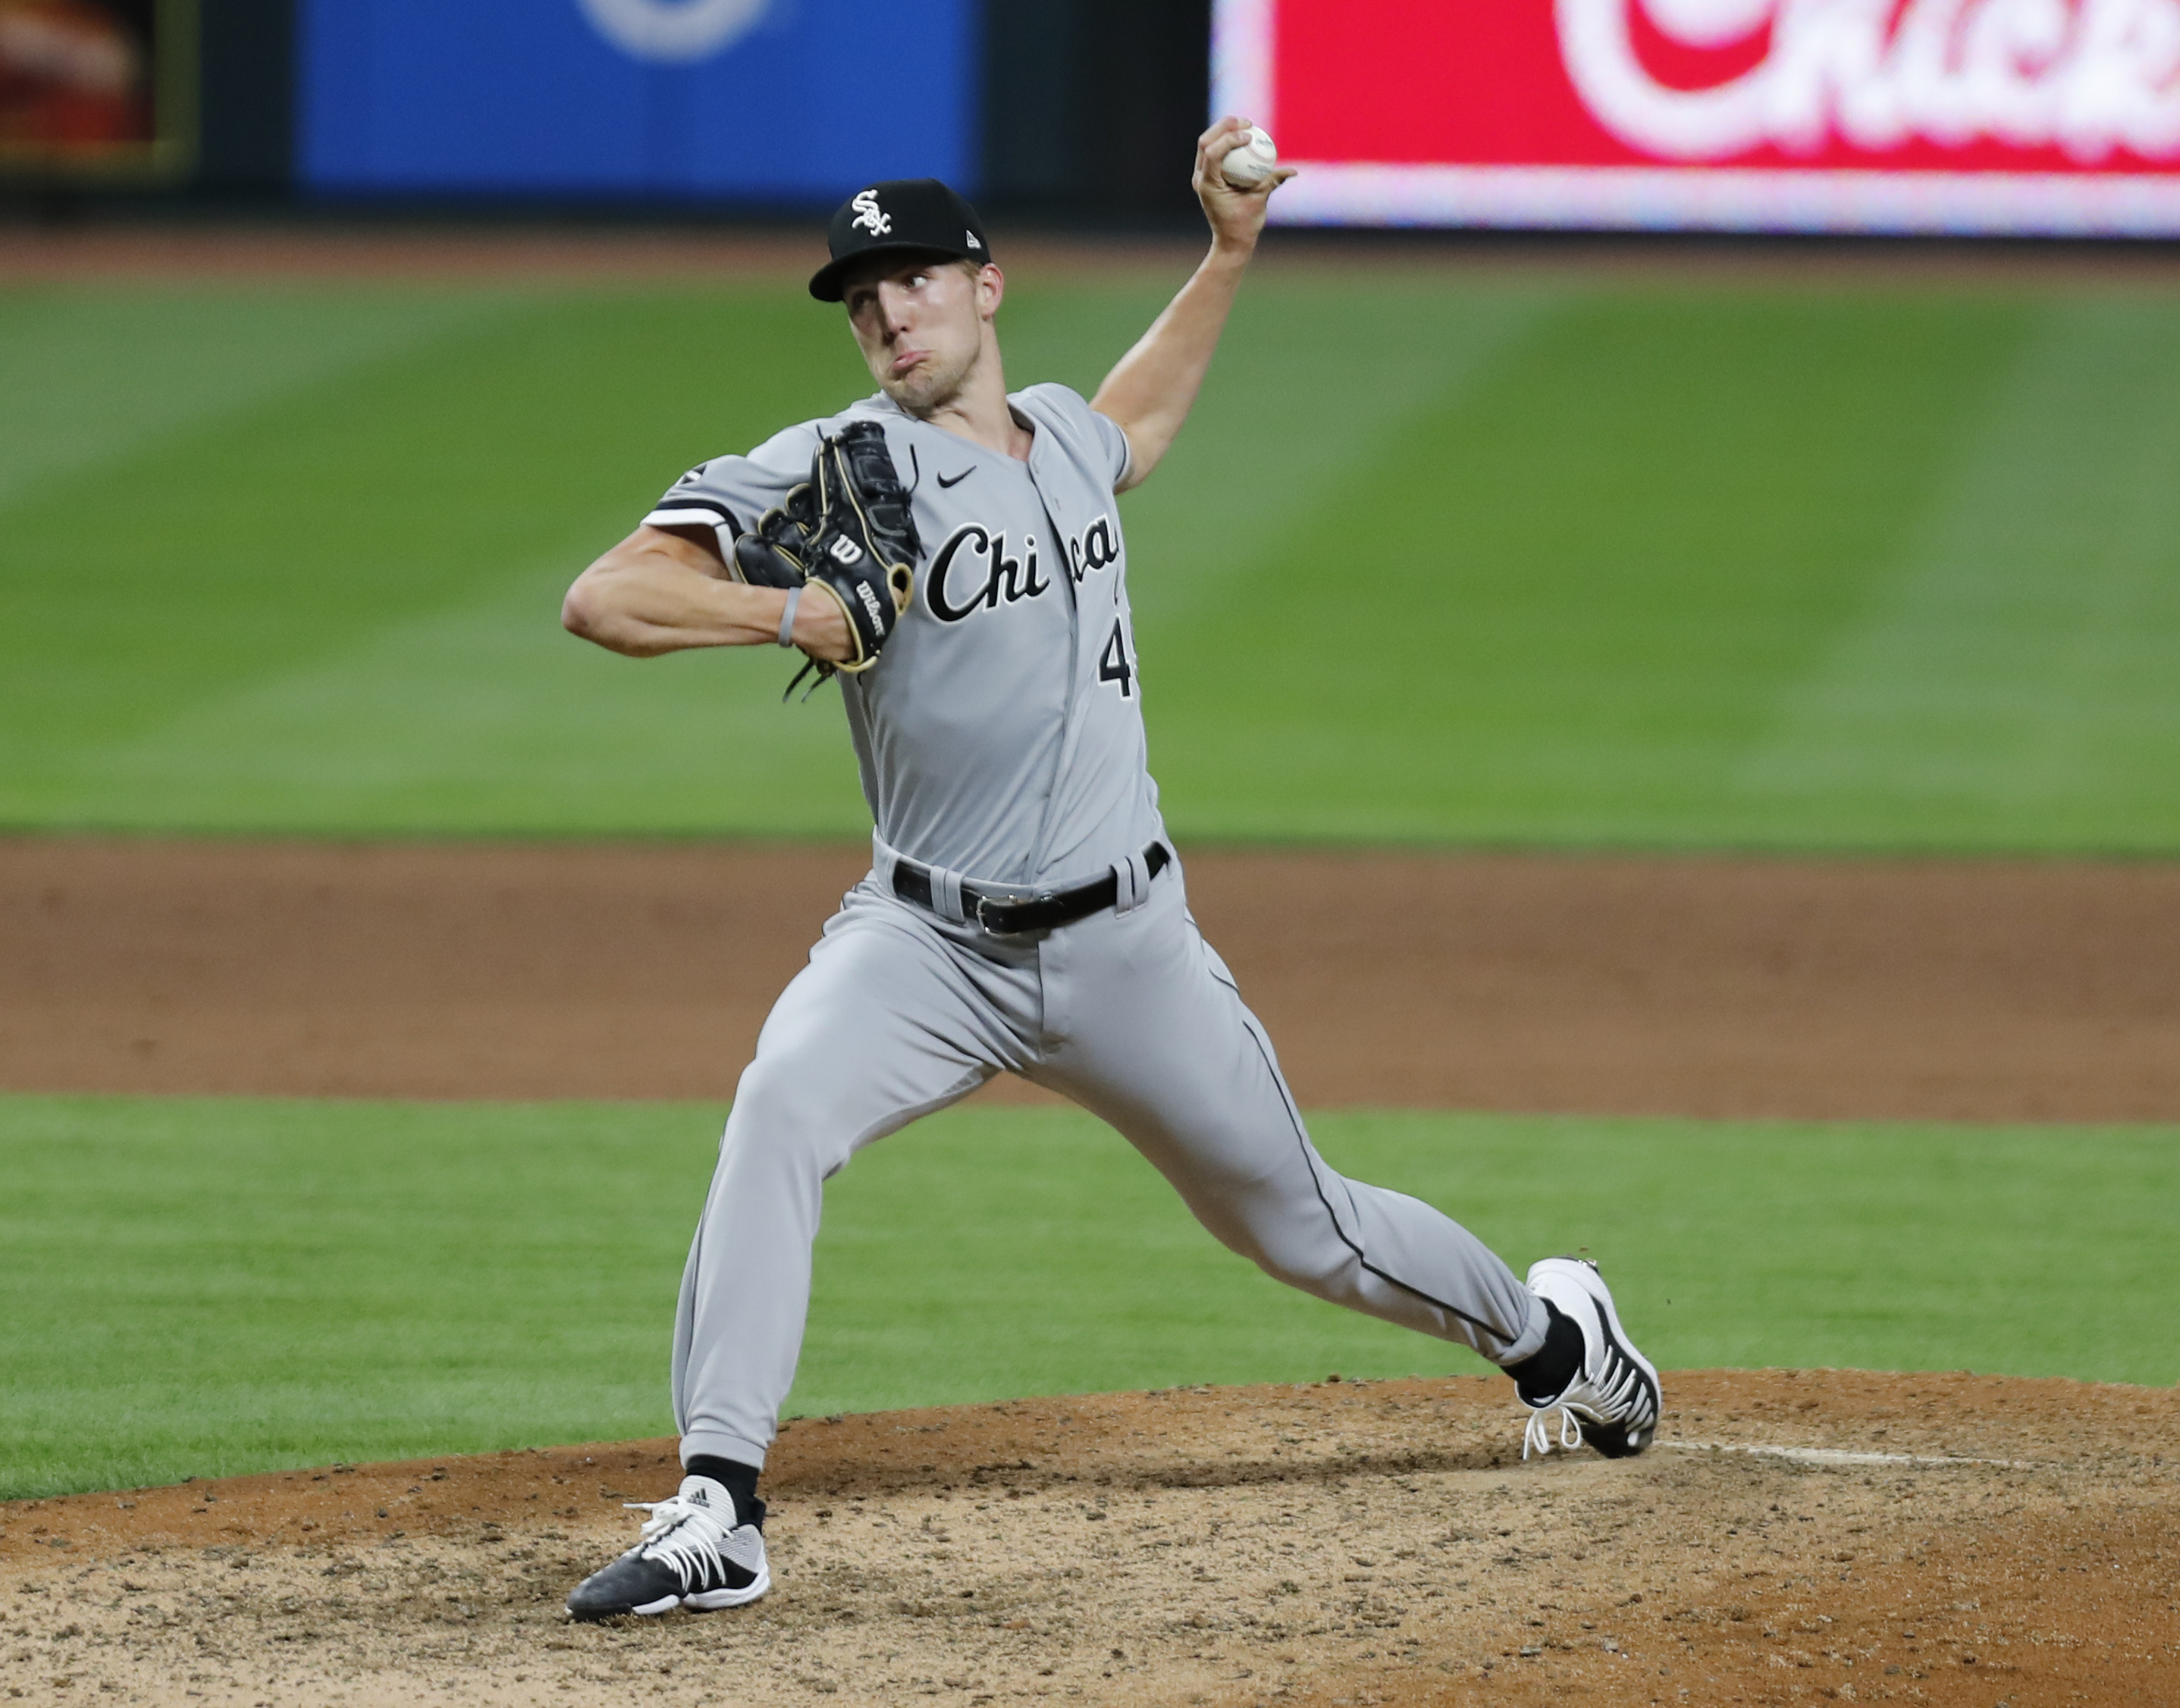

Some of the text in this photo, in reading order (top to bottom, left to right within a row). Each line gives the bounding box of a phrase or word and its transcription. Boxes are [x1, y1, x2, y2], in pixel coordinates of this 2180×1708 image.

[855, 580, 886, 636] Wilson
[924, 512, 1120, 625] Chica
[1097, 613, 1135, 700] 4
